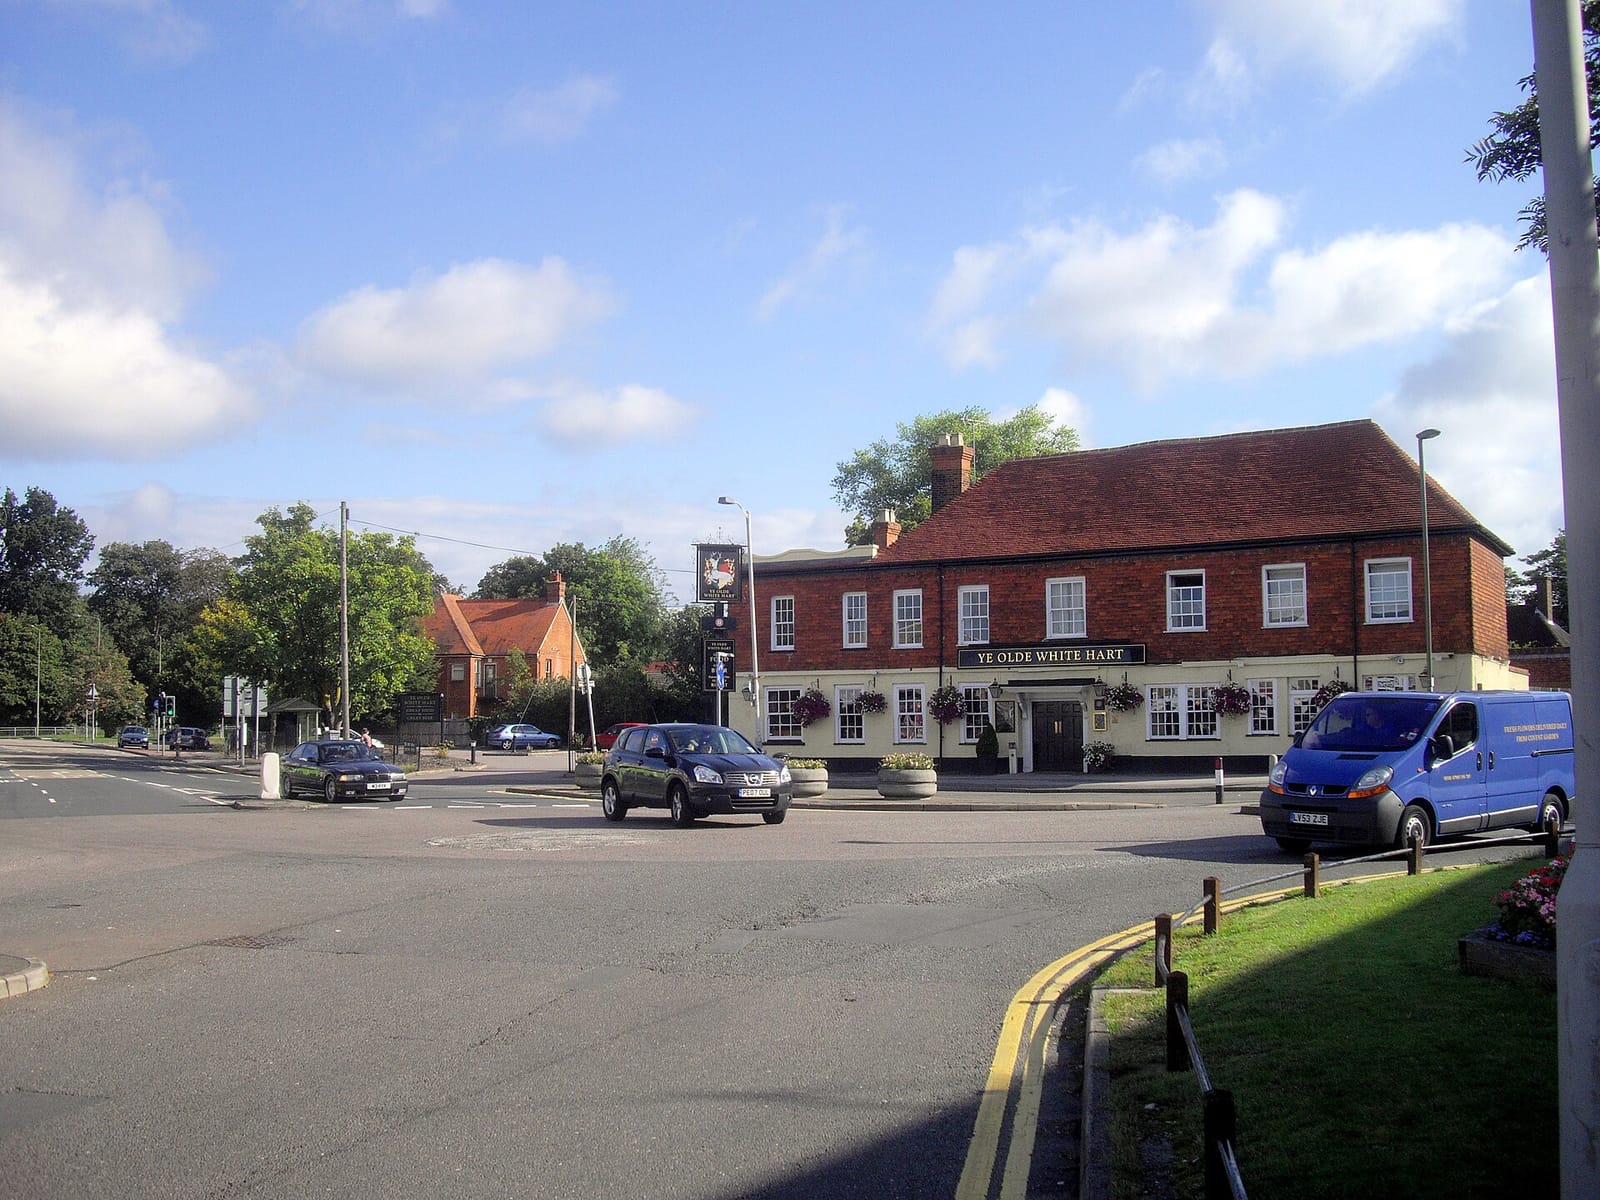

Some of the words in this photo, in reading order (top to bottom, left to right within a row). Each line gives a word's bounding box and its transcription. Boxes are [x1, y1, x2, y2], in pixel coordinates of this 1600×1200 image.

[978, 653, 994, 664] YE
[997, 651, 1033, 663] OLDE
[1036, 650, 1081, 662] WHITE
[1086, 649, 1124, 661] HART
